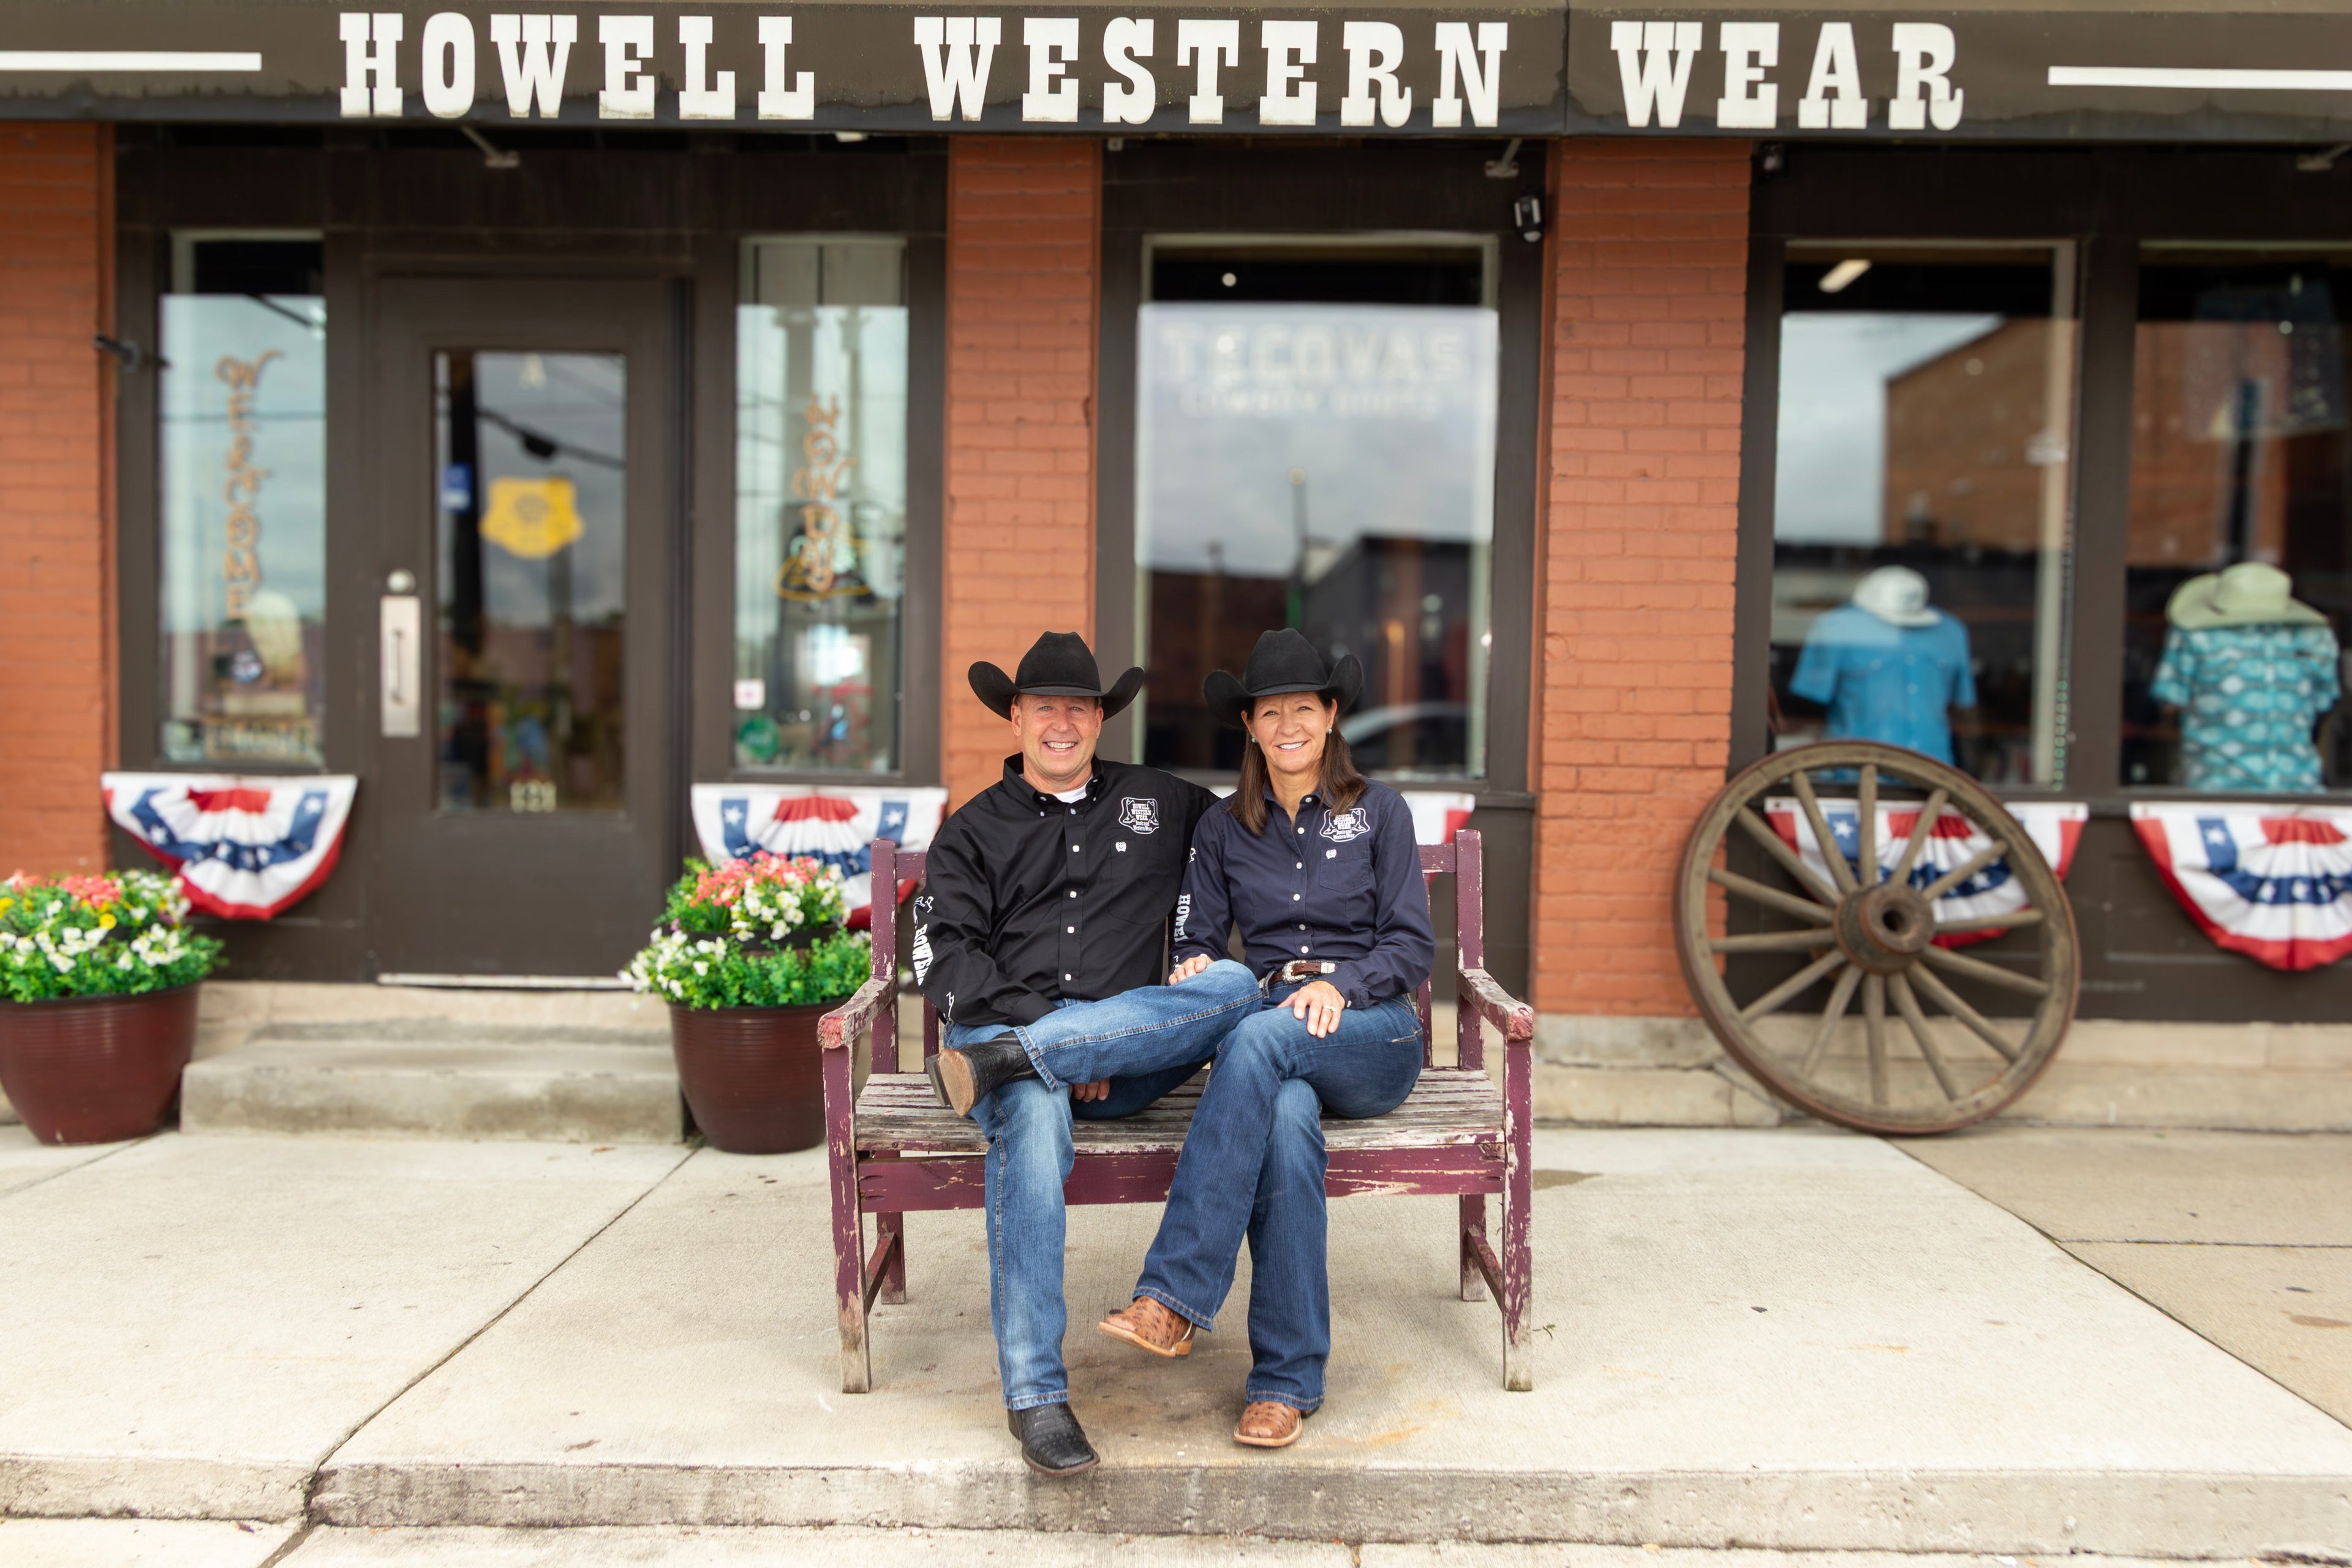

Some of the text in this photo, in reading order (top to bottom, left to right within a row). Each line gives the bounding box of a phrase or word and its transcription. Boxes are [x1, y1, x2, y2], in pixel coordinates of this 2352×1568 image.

[339, 12, 1964, 130] HOWELL WESTERN WEAR
[1159, 323, 1465, 382] TECOVAS
[215, 349, 283, 620] WELCOME
[793, 393, 858, 592] HOWDY
[1174, 894, 1191, 943] HOWEL
